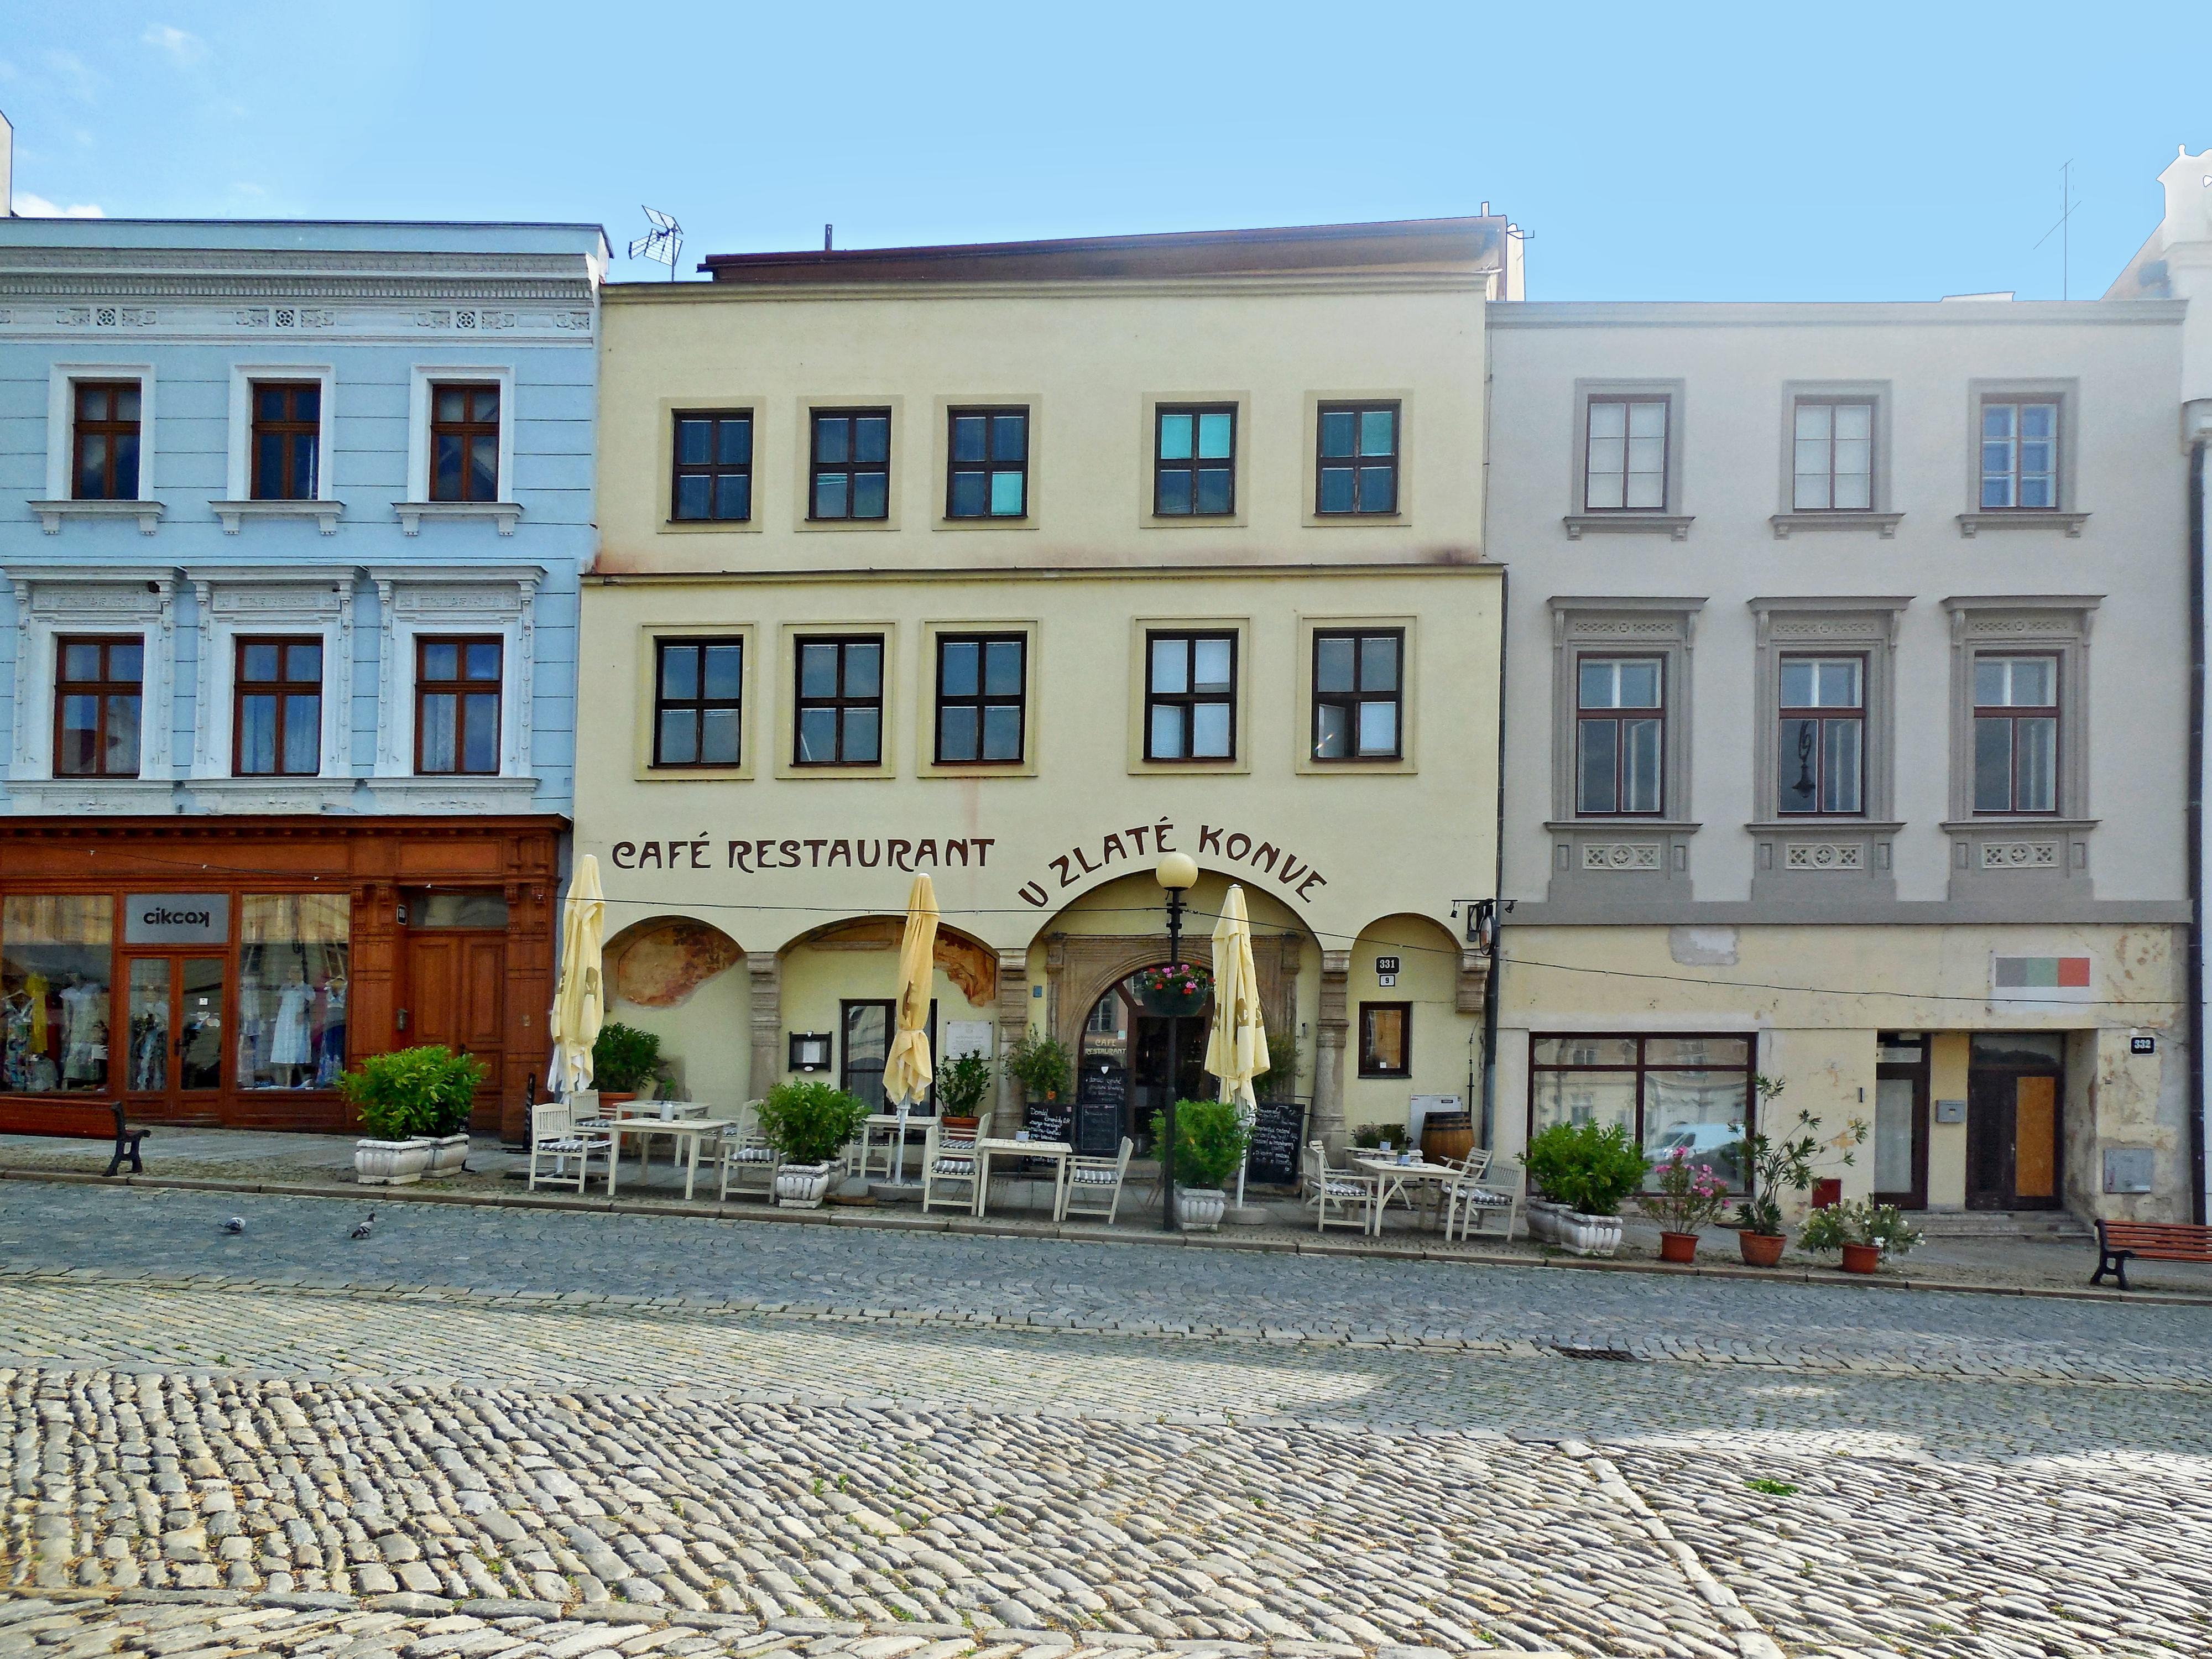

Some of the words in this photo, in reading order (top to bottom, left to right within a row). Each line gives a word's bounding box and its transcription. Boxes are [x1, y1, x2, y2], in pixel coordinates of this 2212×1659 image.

[612, 831, 711, 869] CAFÉ
[728, 839, 995, 874] RESTAURANT
[1018, 880, 1048, 907] U
[1048, 816, 1176, 888] ZLATÉ
[1199, 825, 1328, 904] KONVE
[1379, 959, 1395, 968] 331
